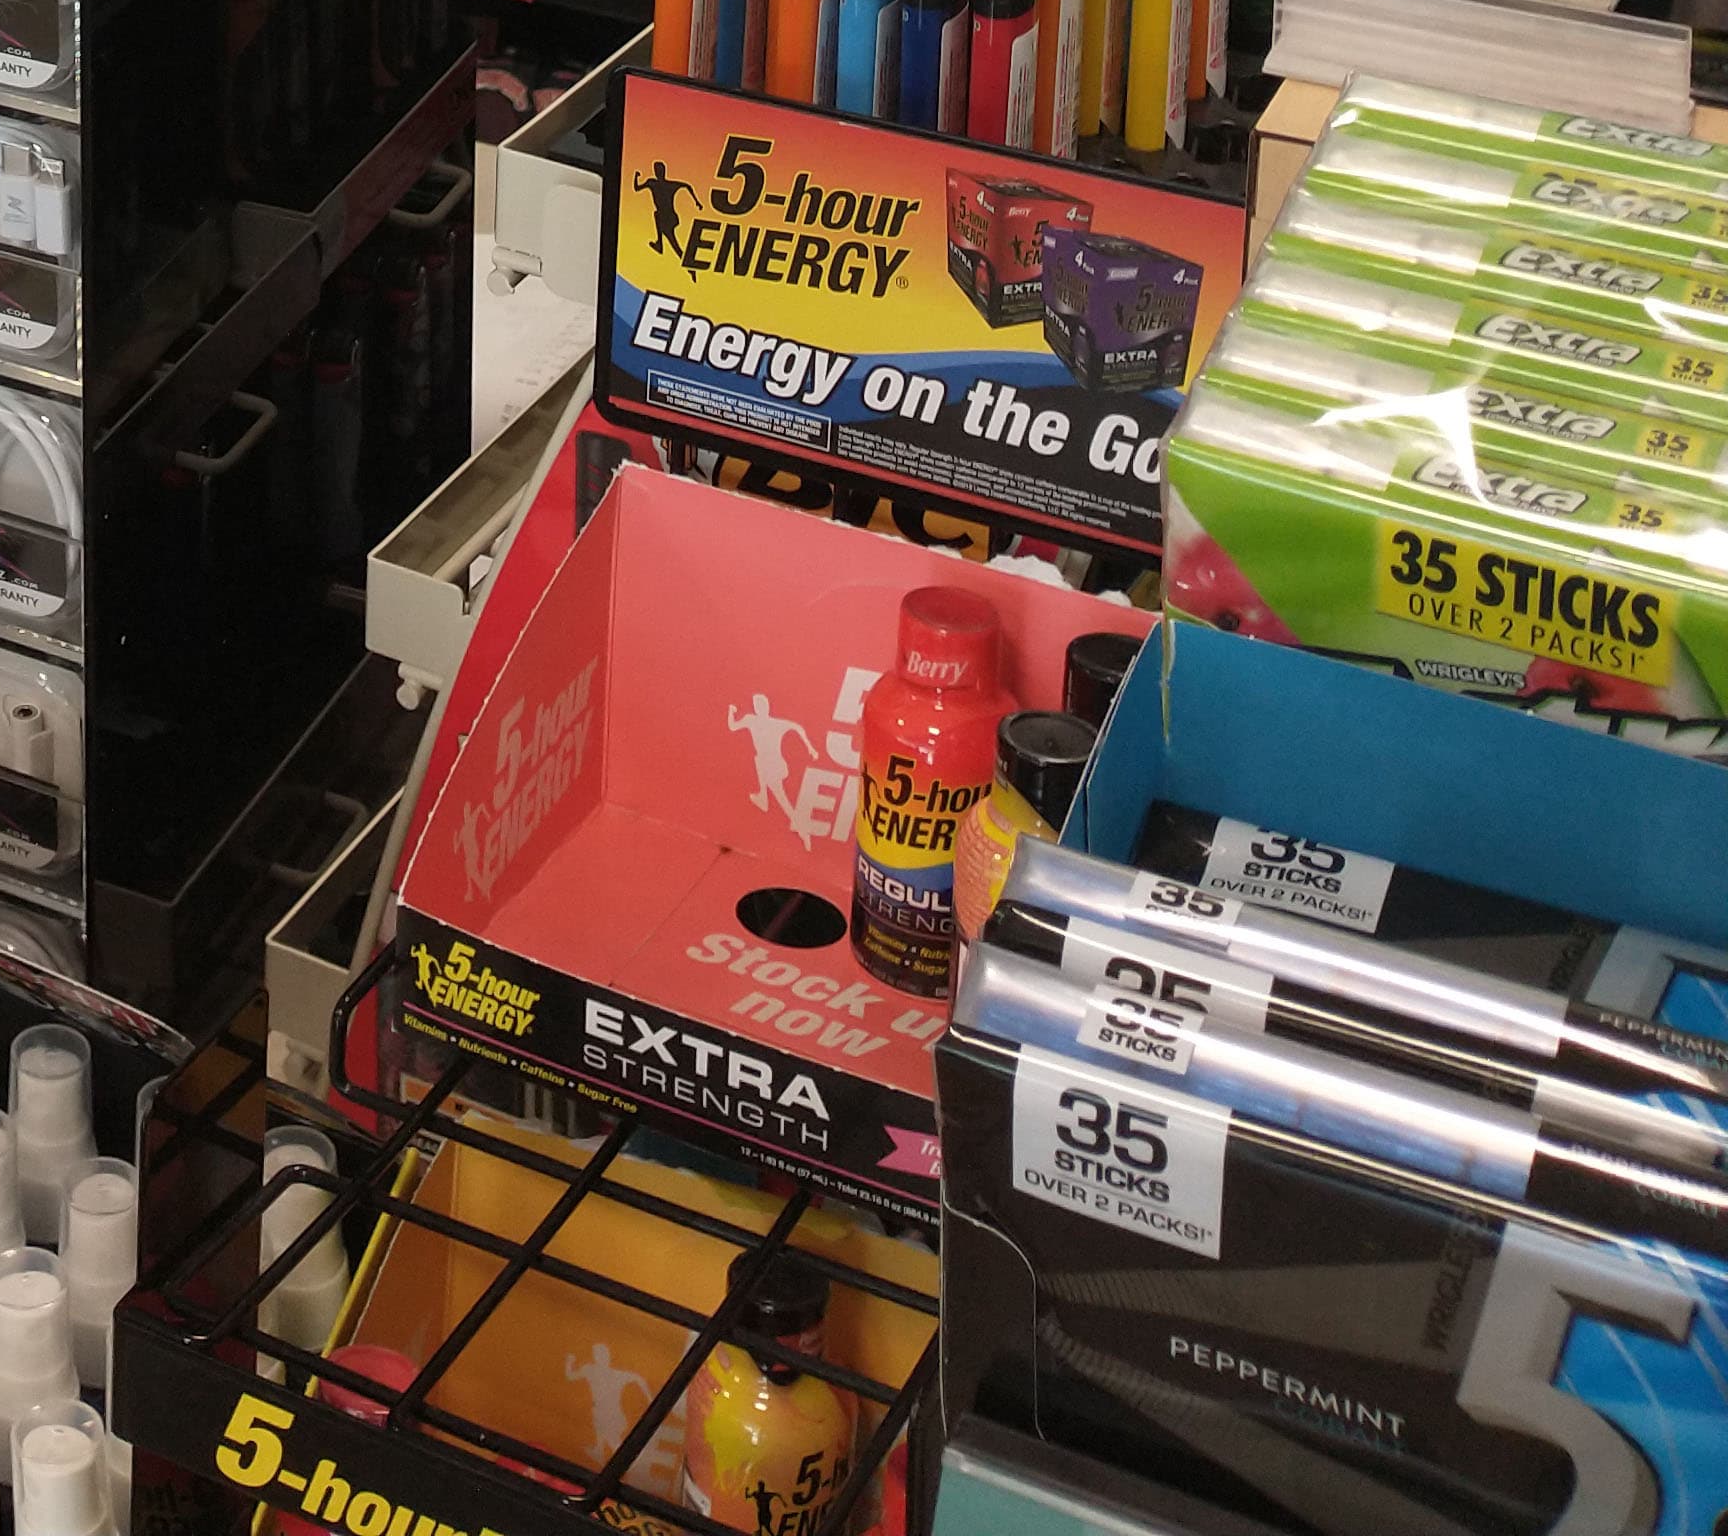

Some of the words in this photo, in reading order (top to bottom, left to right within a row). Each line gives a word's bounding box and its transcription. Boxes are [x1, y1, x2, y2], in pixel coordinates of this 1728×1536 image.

[708, 134, 921, 241] 5-hour
[682, 221, 912, 298] ENERGY
[633, 291, 867, 408] Energy
[862, 366, 946, 425] on
[965, 391, 1067, 457] the
[1389, 528, 1458, 594] 35
[1475, 552, 1661, 649] STICKS
[1408, 592, 1484, 634] OVER
[1500, 618, 1513, 640] 2
[906, 650, 969, 684] Berry
[1416, 659, 1527, 688] WRIGLEY'S
[434, 982, 533, 1036] ENERGY
[444, 939, 541, 1010] 5-hour
[686, 930, 881, 1019] Stock
[585, 998, 831, 1121] EXTRA
[729, 991, 891, 1059] now
[583, 1044, 829, 1153] STRENGTH
[1054, 1086, 1171, 1175] 35
[1053, 1149, 1172, 1204] STICKS
[1169, 1335, 1407, 1438] PEPPERMINT
